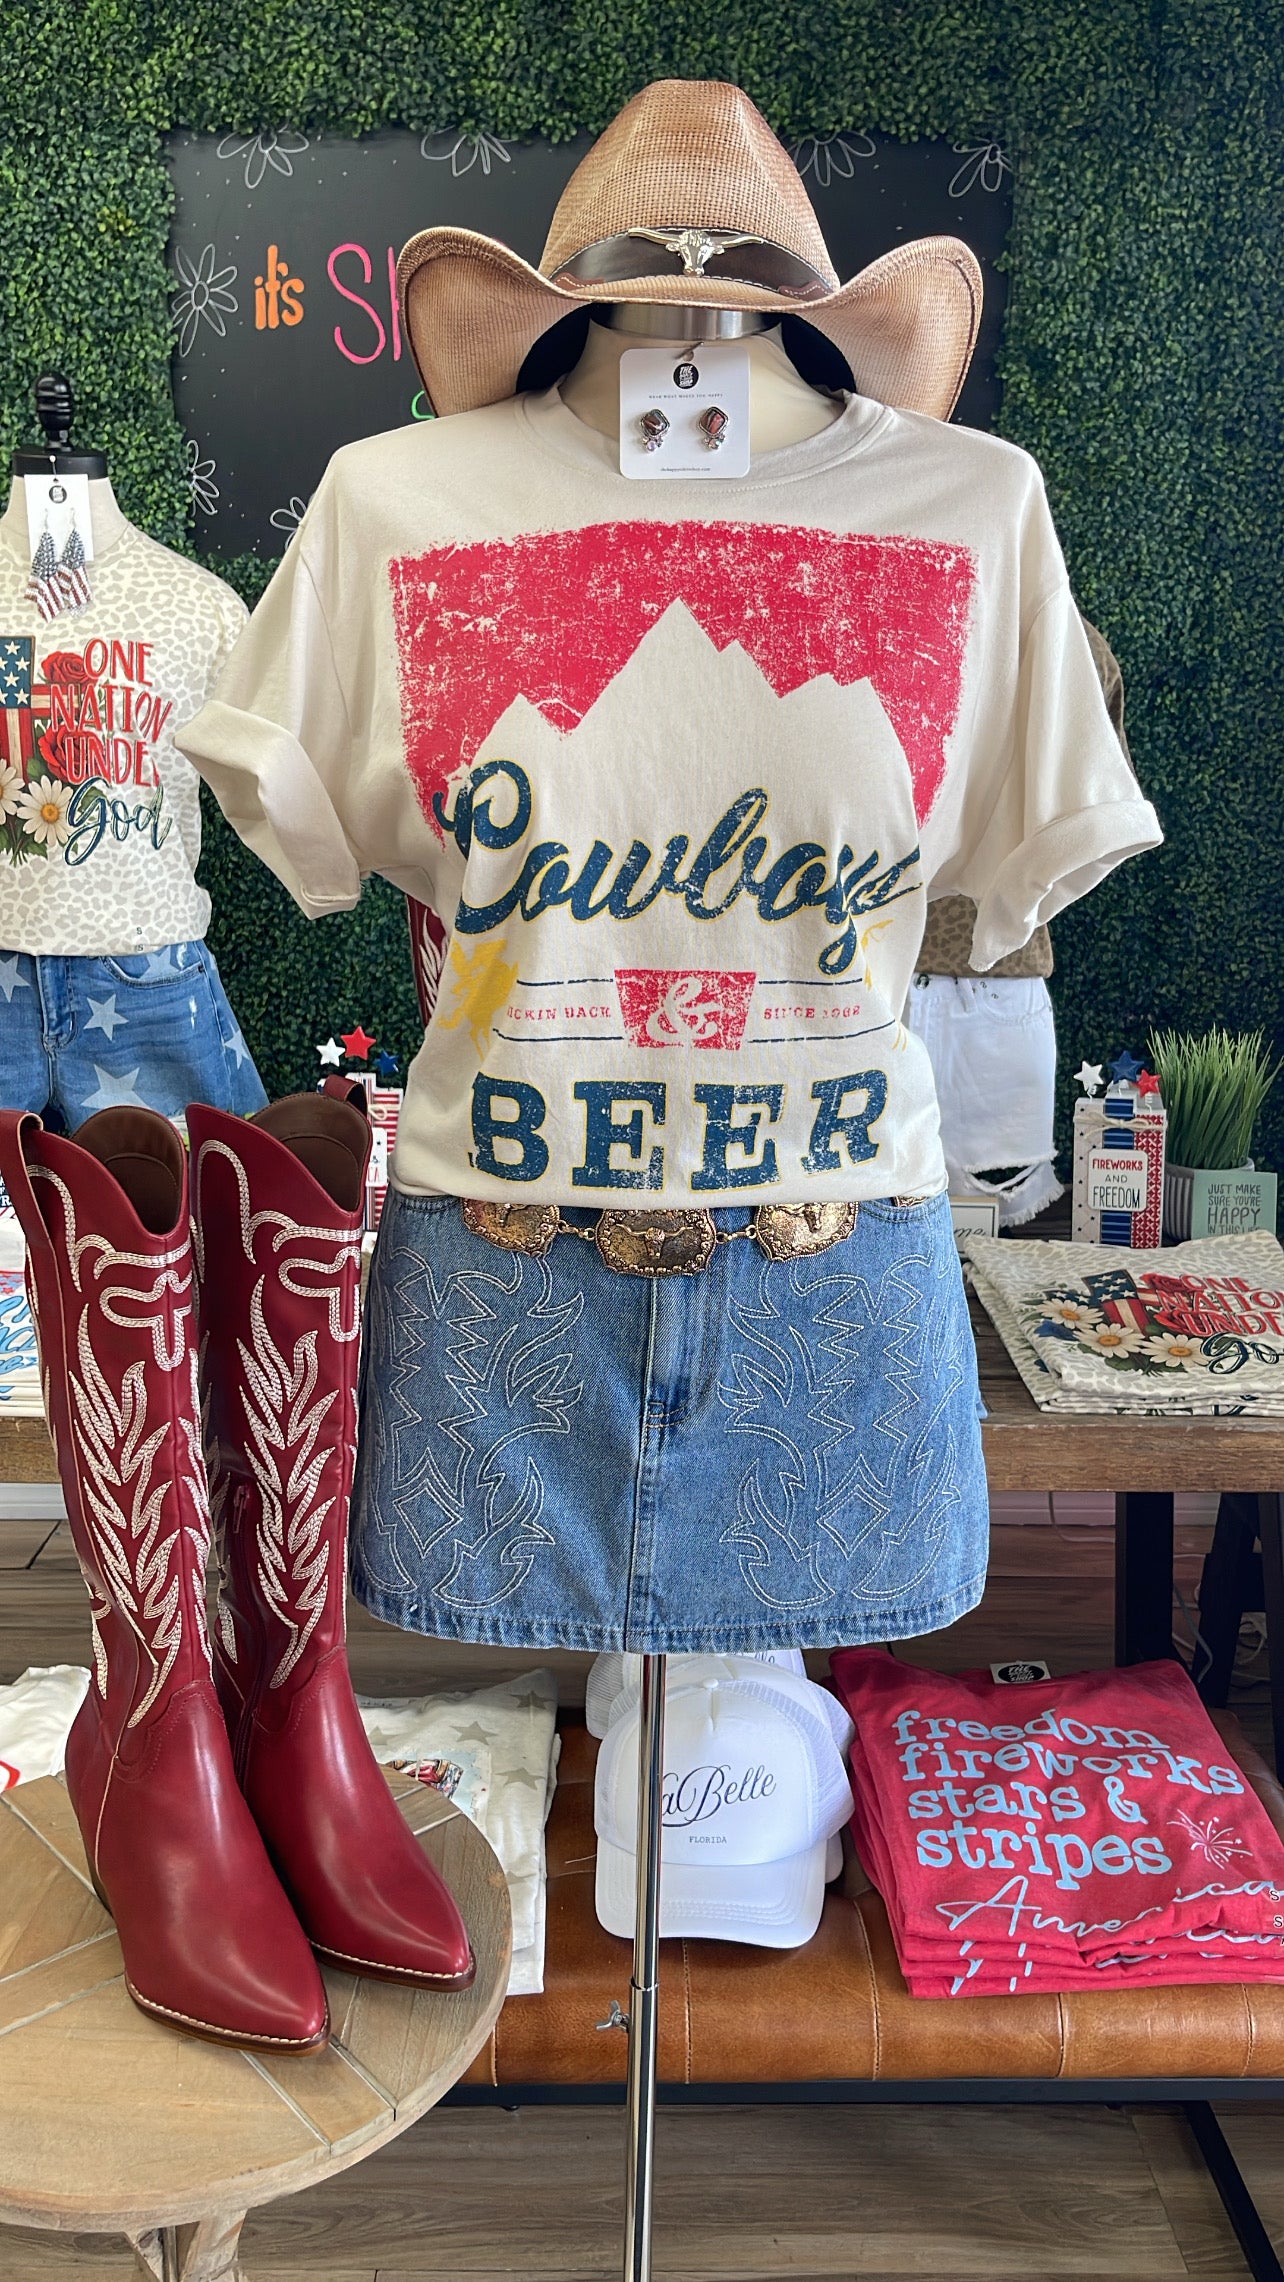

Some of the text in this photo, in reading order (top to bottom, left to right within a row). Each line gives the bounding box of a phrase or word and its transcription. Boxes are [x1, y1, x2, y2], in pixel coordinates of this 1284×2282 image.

[254, 244, 304, 330] it's
[84, 638, 154, 686] ONE
[50, 684, 173, 743] NATION
[468, 1069, 888, 1191] BEER
[1092, 1159, 1143, 1171] FIREWORKS
[1105, 1174, 1128, 1183] AND
[1093, 1186, 1140, 1208] FREEDOM
[1208, 1184, 1261, 1195] JUST MAKE
[1208, 1196, 1230, 1206] SURE
[1208, 1206, 1261, 1226] HAPPY
[1219, 1224, 1240, 1234] THIS
[1180, 1274, 1261, 1292] ONE
[891, 1709, 1170, 1746] freedom
[899, 1741, 1246, 1796] fireworks
[907, 1775, 1149, 1825] stars &
[689, 1835, 727, 1843] FLORIDA
[916, 1819, 1174, 1891] stripes
[1269, 1890, 1280, 1901] S
[1274, 1916, 1283, 1928] S
